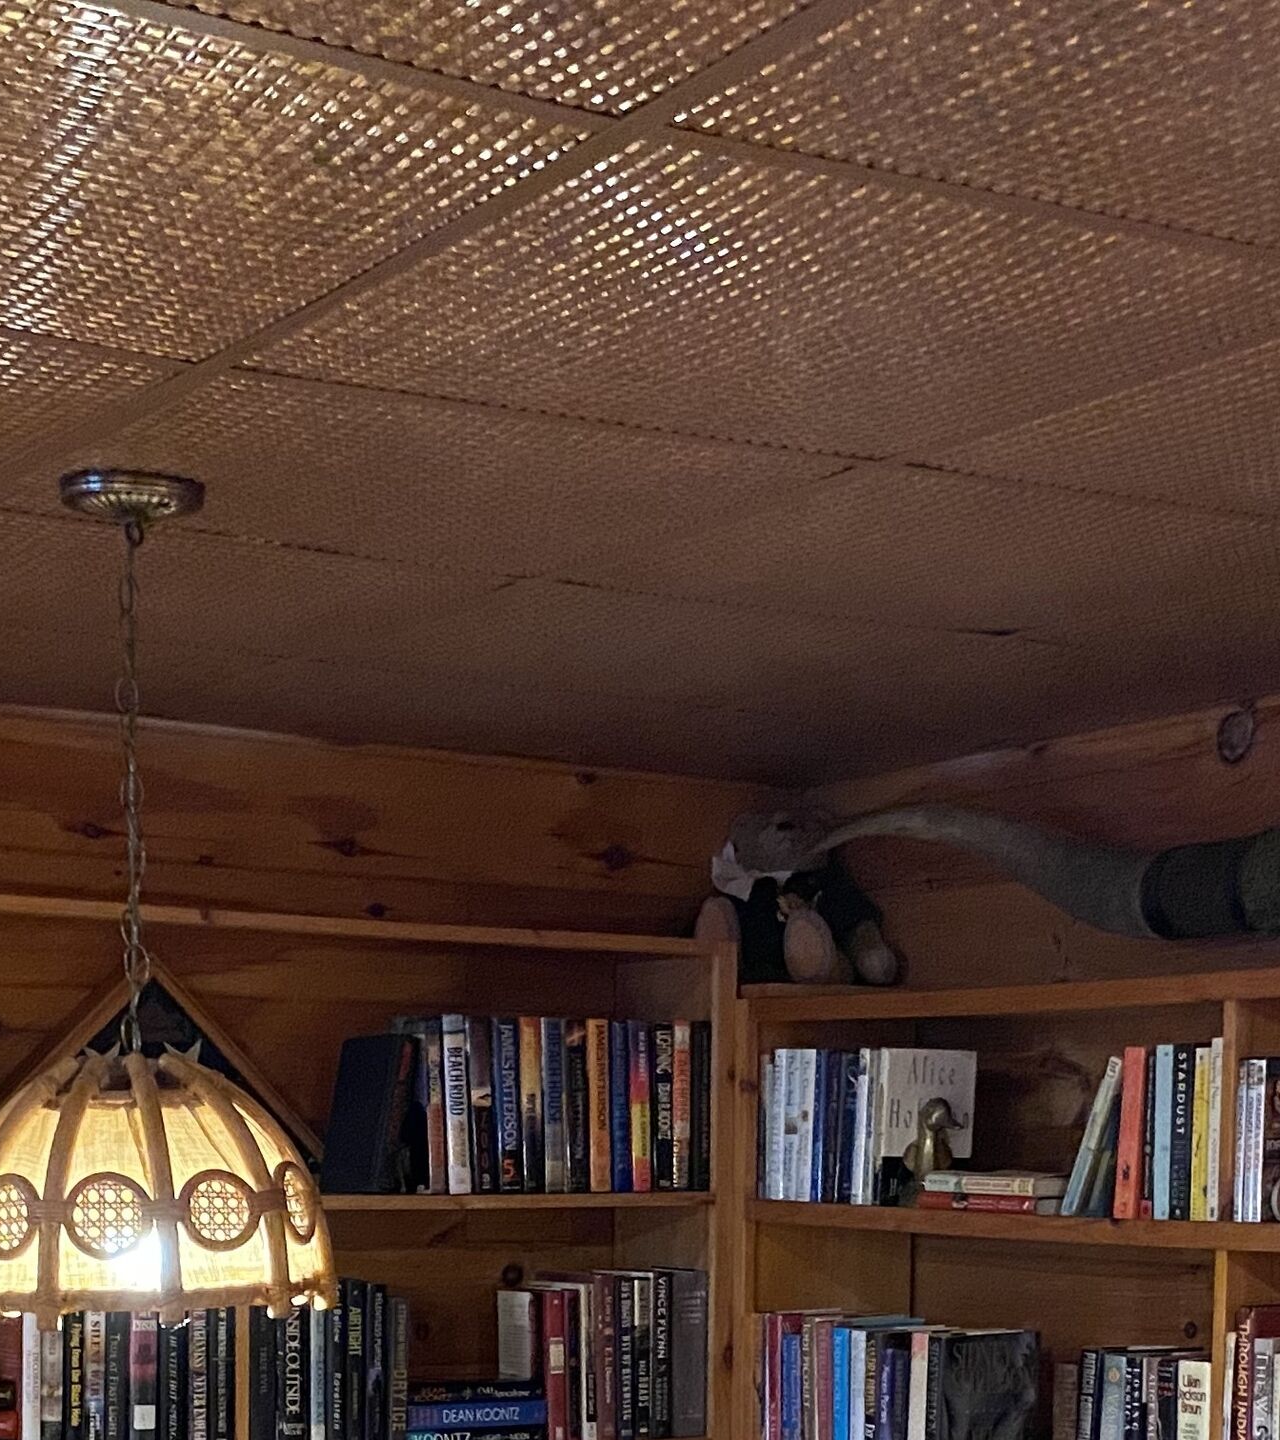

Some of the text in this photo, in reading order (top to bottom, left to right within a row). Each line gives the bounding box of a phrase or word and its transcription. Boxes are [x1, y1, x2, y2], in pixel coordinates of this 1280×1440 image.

[448, 1047, 464, 1115] BEACH ROAD
[499, 1024, 517, 1151] JAMES PATTERSON
[547, 1034, 562, 1124] BEACH HOUSE
[1176, 1051, 1187, 1135] STARDUST
[348, 1306, 362, 1356] AIRTIGHT
[656, 1276, 666, 1359] VINCE FLYNN
[68, 1323, 82, 1427] Flying from the Black Hole
[108, 1333, 121, 1437] TRUE AT FIRST LIGHT
[285, 1352, 303, 1416] OUTSIDE
[802, 1352, 811, 1409] PICOULT
[1082, 1352, 1097, 1394] PATRICIA
[1182, 1375, 1200, 1389] Lilian
[1237, 1321, 1250, 1397] THROUGH
[1256, 1353, 1269, 1392] THE
[392, 1369, 407, 1432] DRY ICE
[443, 1406, 519, 1424] DEAN KOONTZ
[1147, 1372, 1157, 1410] ALICE
[1181, 1402, 1202, 1416] Braun
